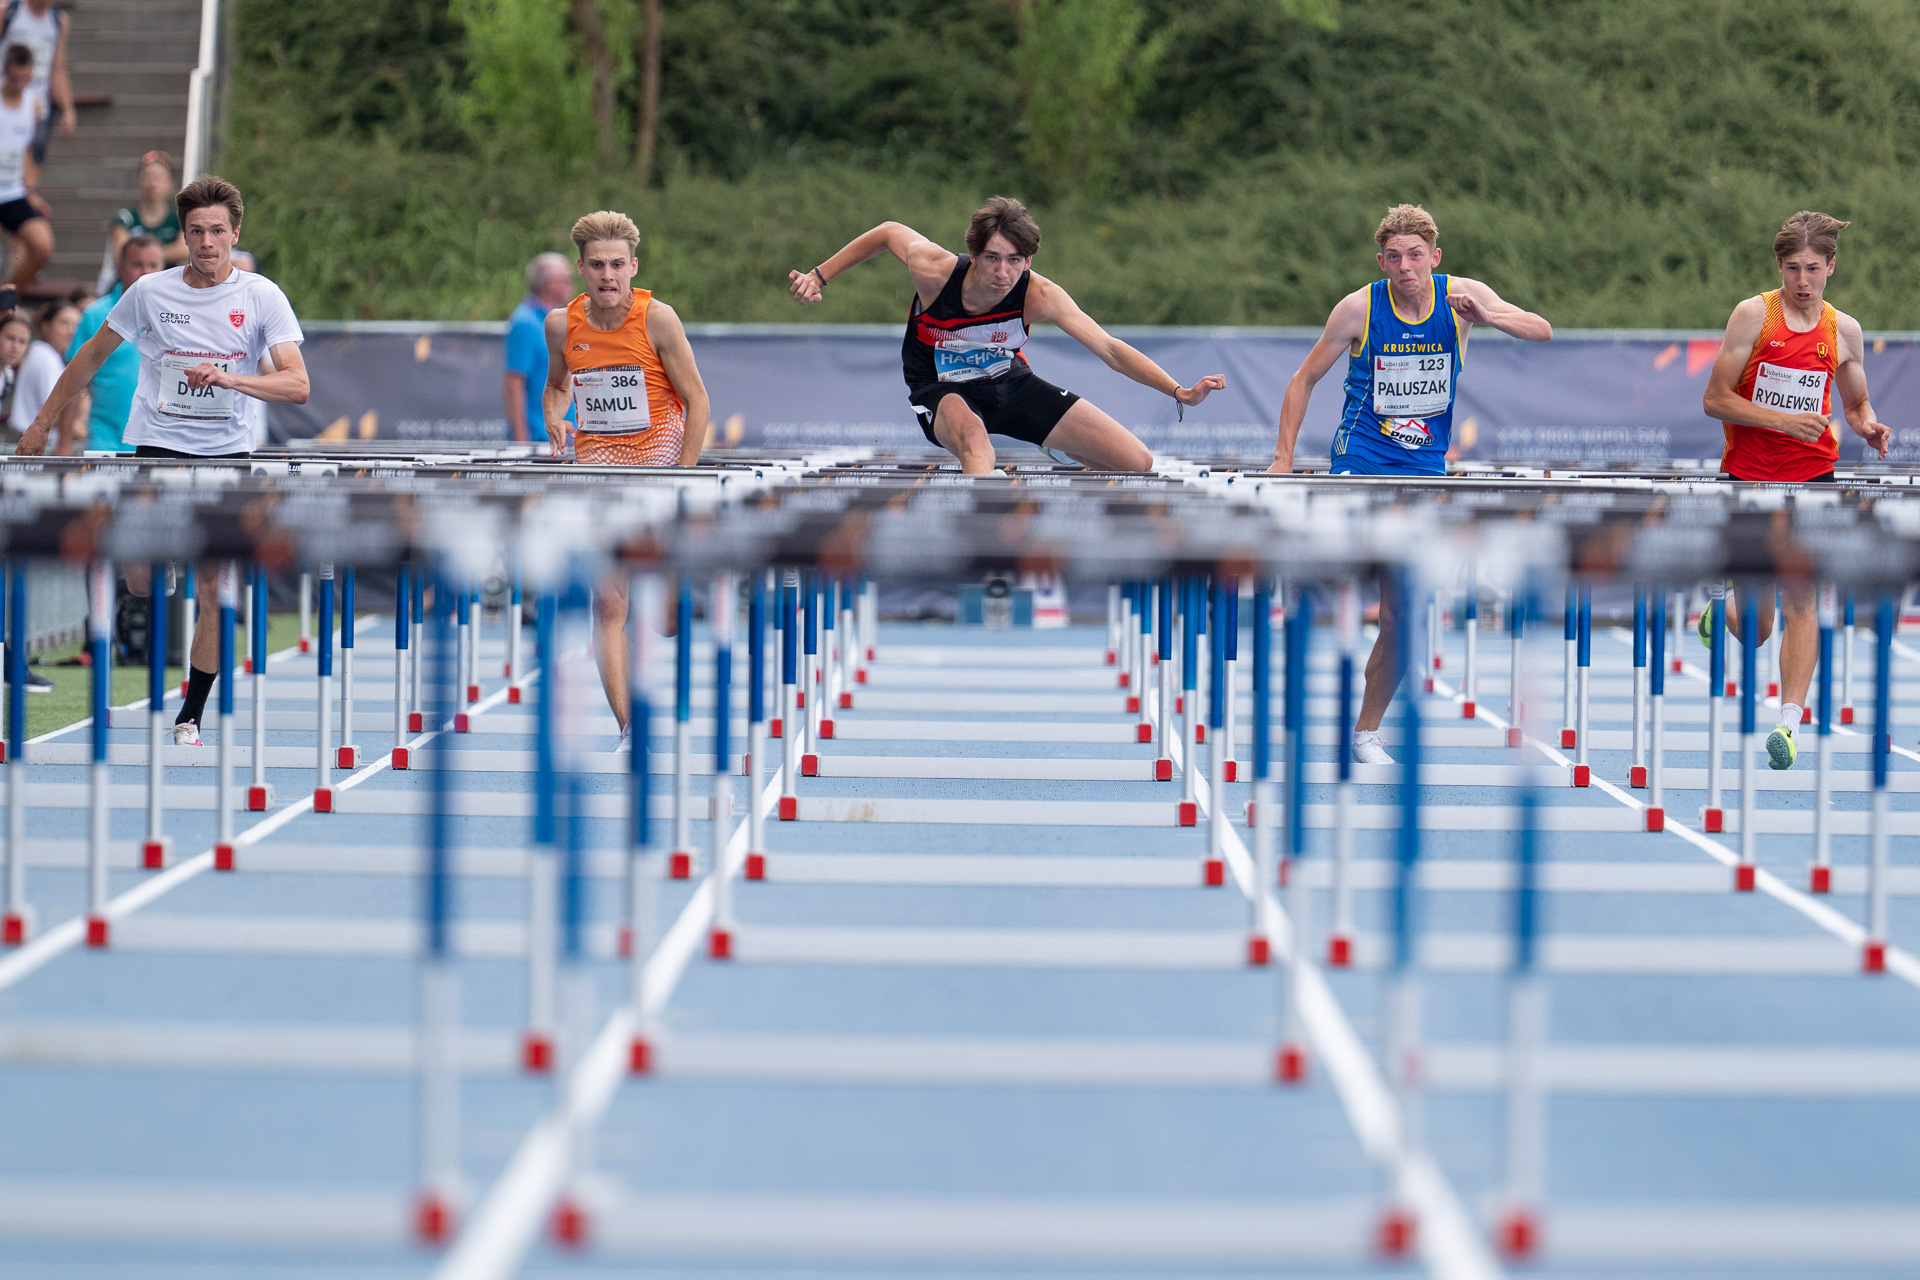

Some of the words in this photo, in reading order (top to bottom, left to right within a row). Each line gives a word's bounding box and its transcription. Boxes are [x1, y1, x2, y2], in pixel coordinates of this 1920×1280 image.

[1383, 343, 1443, 352] KRUSZWICA
[1418, 357, 1446, 371] 123
[611, 375, 638, 388] 386
[1377, 379, 1448, 396] PALUSZAK
[1797, 374, 1821, 388] 456
[585, 396, 638, 412] SAMUL
[1755, 387, 1820, 412] RYDLEWSKI
